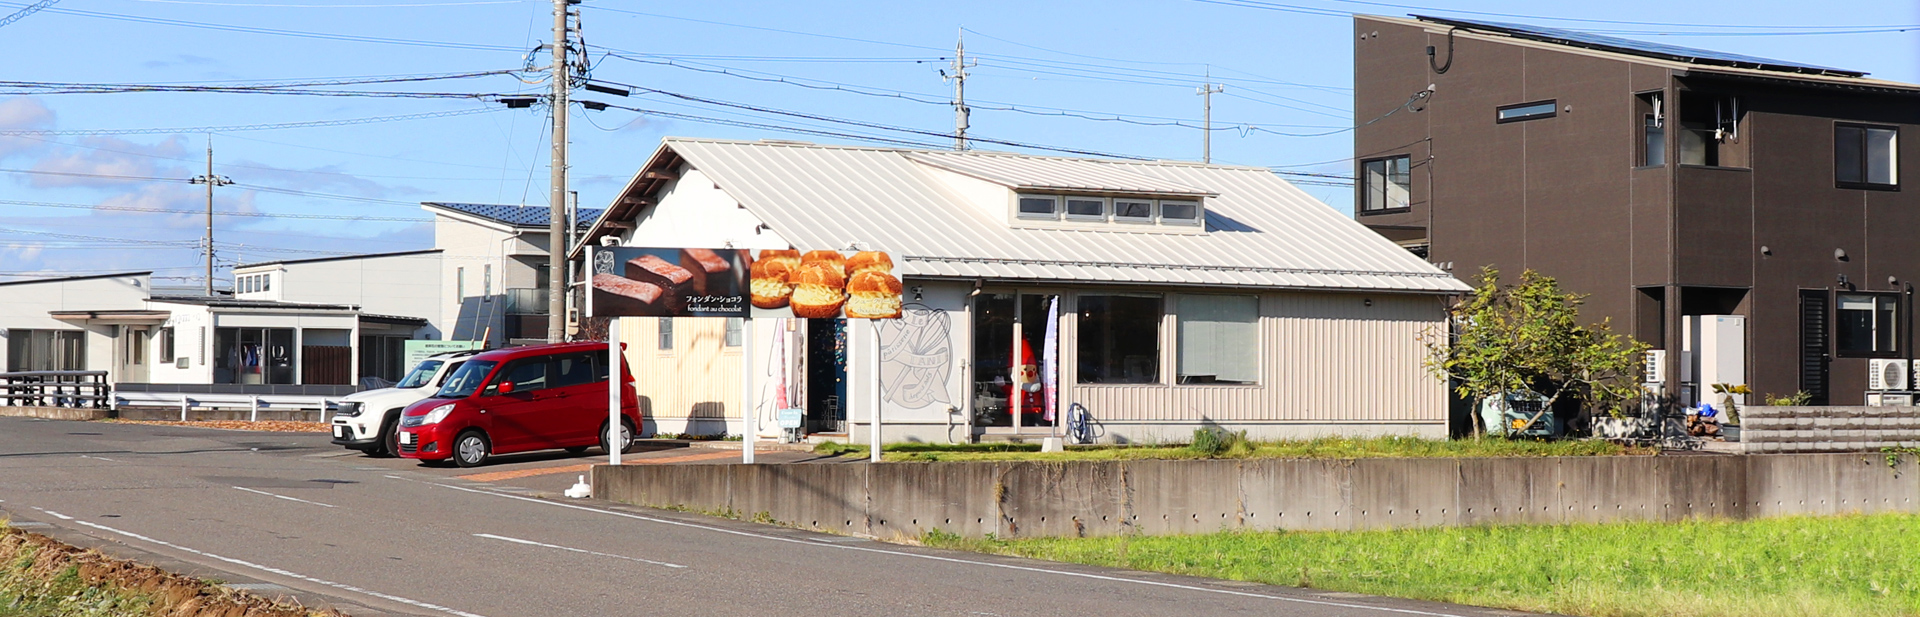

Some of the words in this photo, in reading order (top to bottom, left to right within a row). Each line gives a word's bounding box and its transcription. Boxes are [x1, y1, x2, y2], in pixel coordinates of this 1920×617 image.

[686, 294, 742, 303] フォンダン・ショコラ
[687, 303, 709, 312] fondant
[718, 303, 742, 312] chocolat
